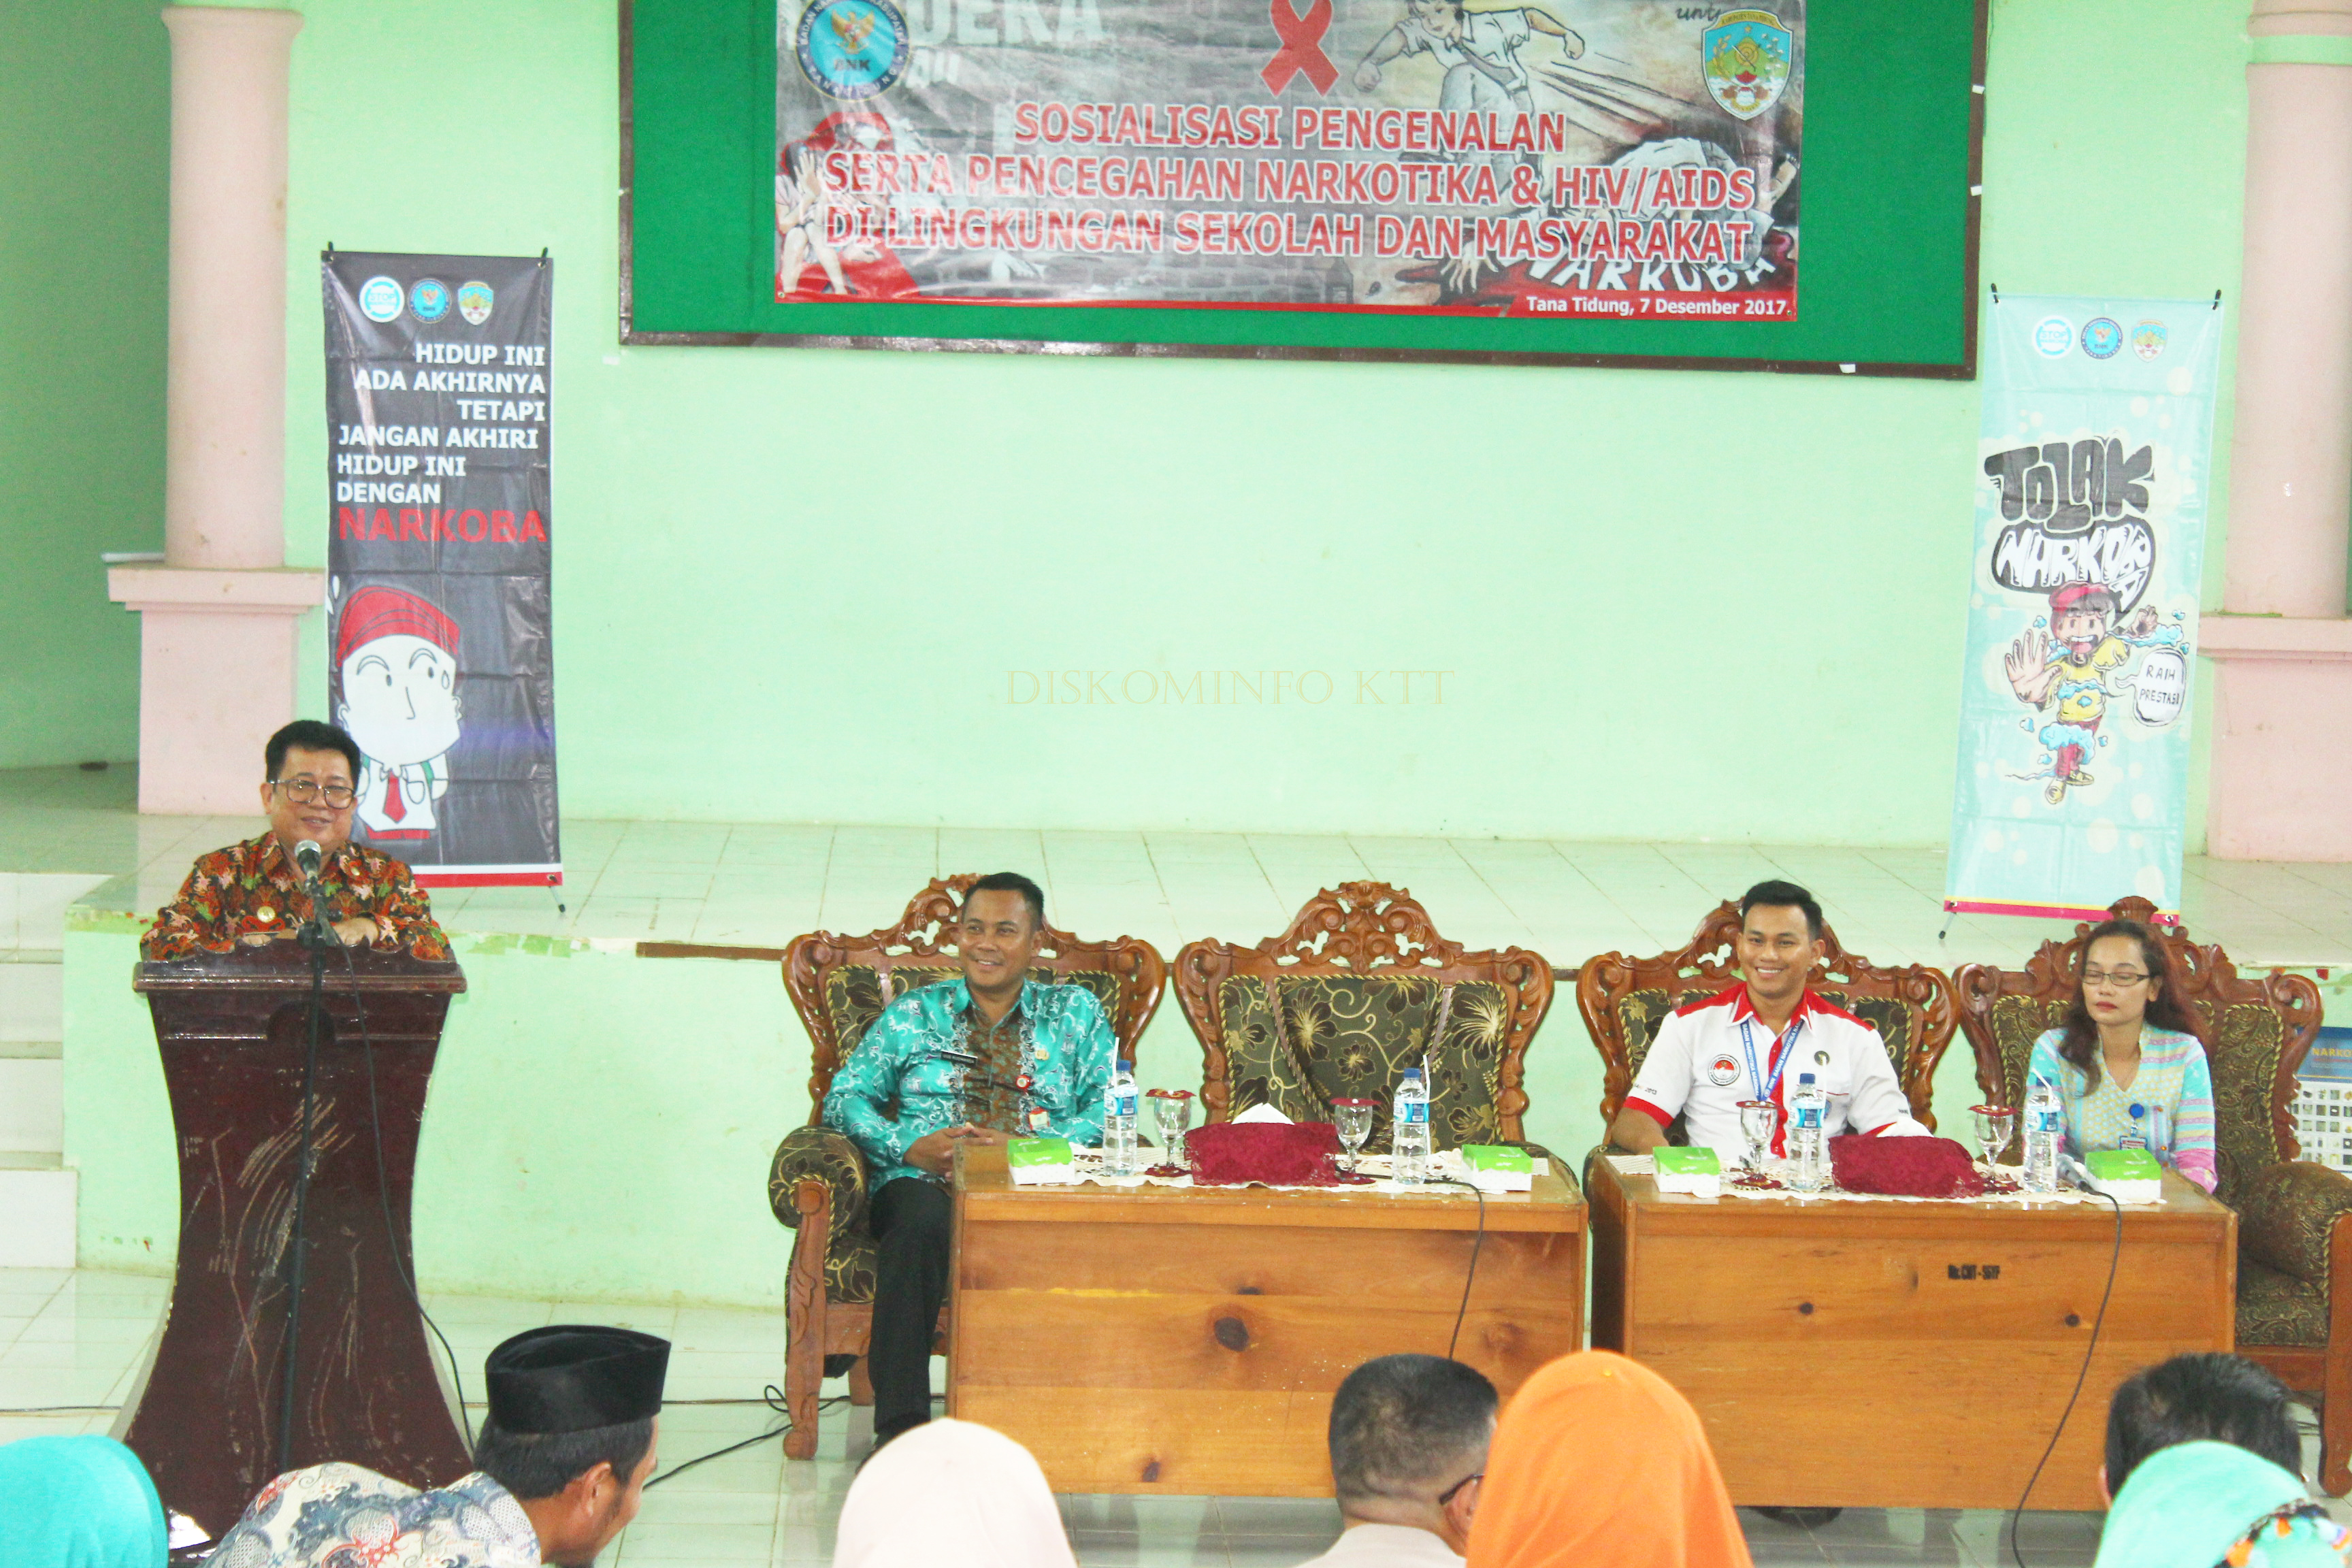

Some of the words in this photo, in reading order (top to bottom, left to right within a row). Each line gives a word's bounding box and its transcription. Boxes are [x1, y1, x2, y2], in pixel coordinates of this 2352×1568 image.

[1015, 103, 1281, 148] SOSIALISASI
[1294, 109, 1565, 152] PENGENALAN
[823, 152, 953, 195] SERTA
[968, 156, 1243, 200] PENCEGAHAN
[1258, 162, 1497, 206] NARKOTIKA
[1512, 164, 1541, 206] &
[1555, 165, 1754, 215] HIV/AIDS
[826, 206, 877, 247] DI
[886, 208, 1161, 252] LINGKUNGAN
[1174, 213, 1361, 255] SEKOLAH
[1377, 217, 1461, 257] DAN
[1476, 218, 1752, 263] MASYARAKAT
[1526, 296, 1567, 312] Tana
[1572, 297, 1634, 316] Tidung,
[1640, 298, 1650, 312] 7
[1656, 298, 1740, 314] Desember
[1744, 300, 1786, 315] 2017
[416, 343, 497, 364] HIDUP
[504, 346, 545, 366] INI
[355, 370, 407, 391] ADA
[413, 372, 545, 393] AKHIRNYA
[457, 400, 544, 421] TETAPI
[339, 425, 438, 446] JANGAN
[446, 428, 538, 448] AKHIRI
[338, 455, 418, 475] HIDUP
[425, 457, 466, 476] INI
[338, 483, 440, 504] DENGAN
[1984, 438, 2154, 531] TOLAK
[338, 507, 547, 542] NARKOBA
[1996, 523, 2151, 612] NARKOBA
[2146, 664, 2176, 681] RAIH
[2139, 688, 2180, 705] PRESTASI
